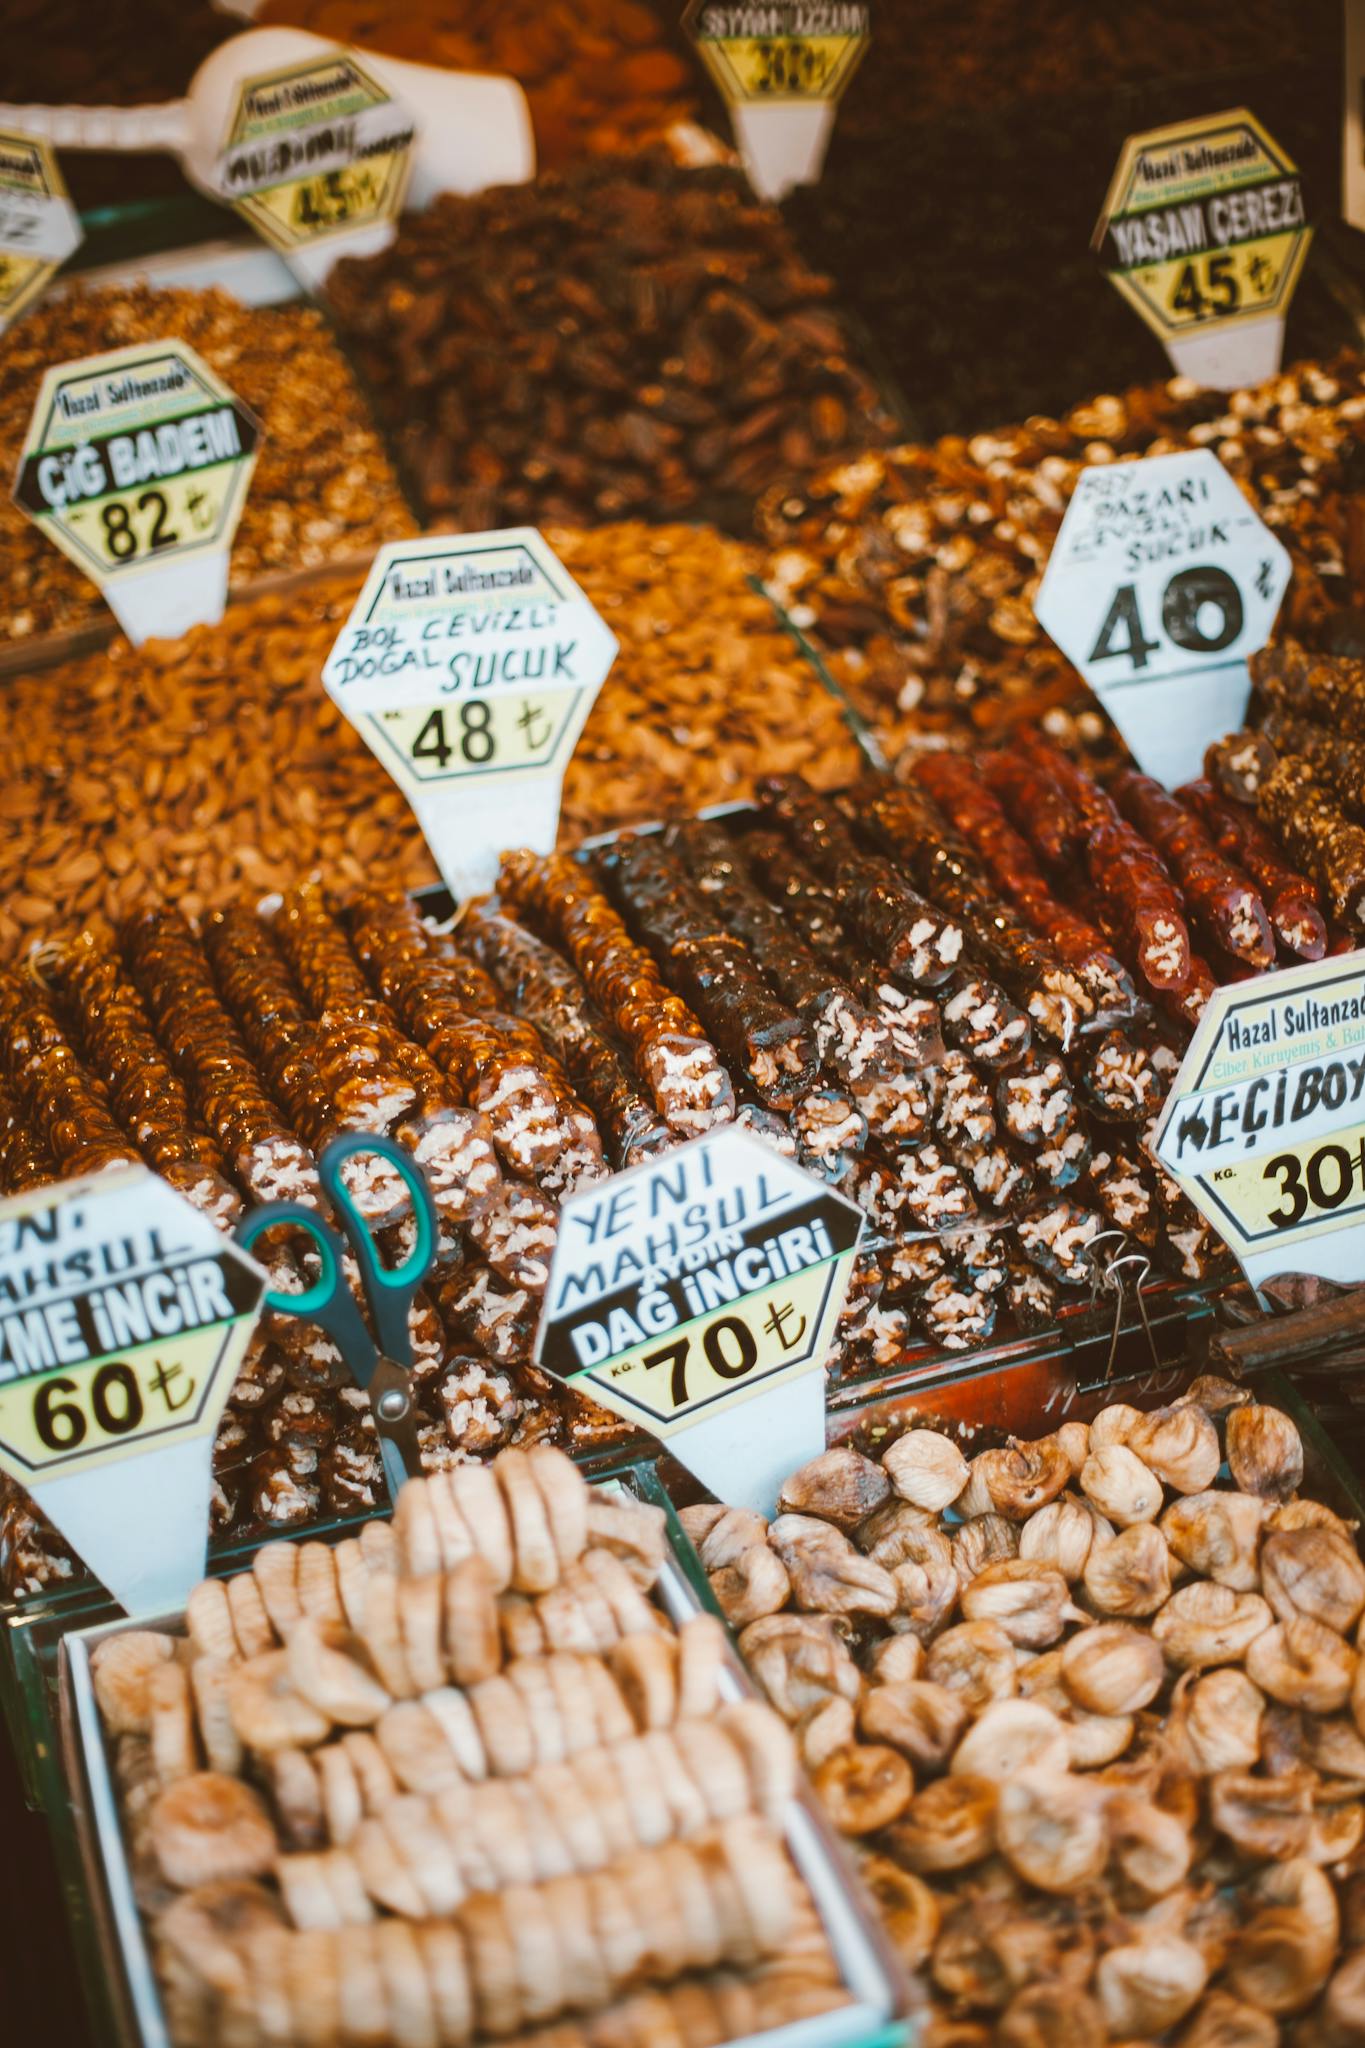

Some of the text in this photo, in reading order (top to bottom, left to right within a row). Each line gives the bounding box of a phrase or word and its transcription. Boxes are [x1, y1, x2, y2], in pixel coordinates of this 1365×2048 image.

[1173, 254, 1241, 320] 45
[108, 408, 242, 488] BADEM
[102, 491, 178, 559] 82
[352, 626, 406, 651] BOL
[1088, 565, 1244, 669] 40
[441, 640, 577, 693] SUCUK
[411, 699, 497, 769] 48
[1227, 1007, 1278, 1052] Hazal
[1214, 1167, 1237, 1182] KG.
[557, 1174, 792, 1310] MAHSUL
[643, 1315, 758, 1407] 70
[33, 1362, 143, 1451] 60
